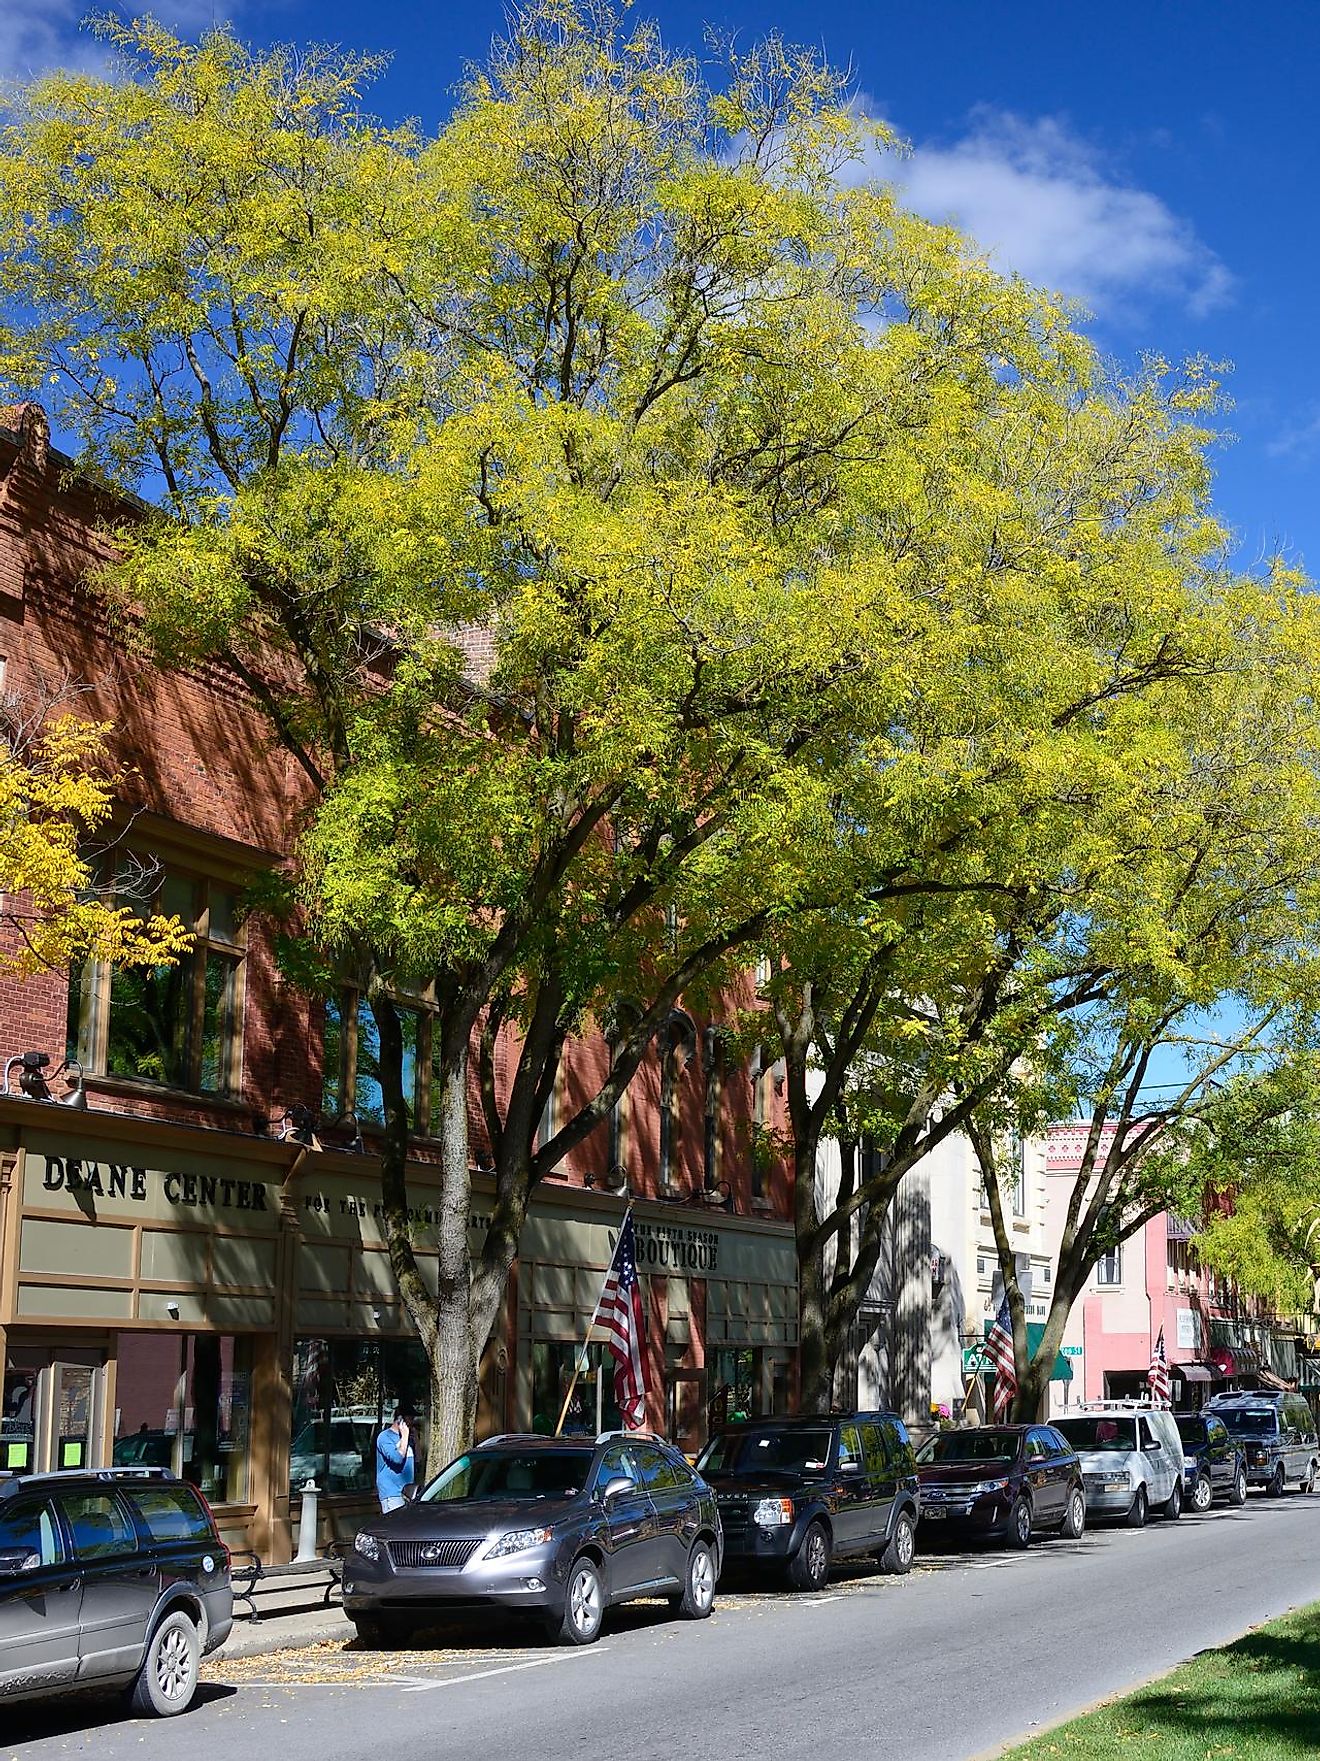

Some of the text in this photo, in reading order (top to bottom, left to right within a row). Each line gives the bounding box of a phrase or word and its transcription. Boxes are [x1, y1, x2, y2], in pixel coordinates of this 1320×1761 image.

[43, 1155, 268, 1211] DEANE CENTER
[340, 1199, 366, 1217] THE
[634, 1223, 719, 1244] THE FIFTH SEASON
[635, 1237, 718, 1270] BOUTIQUE
